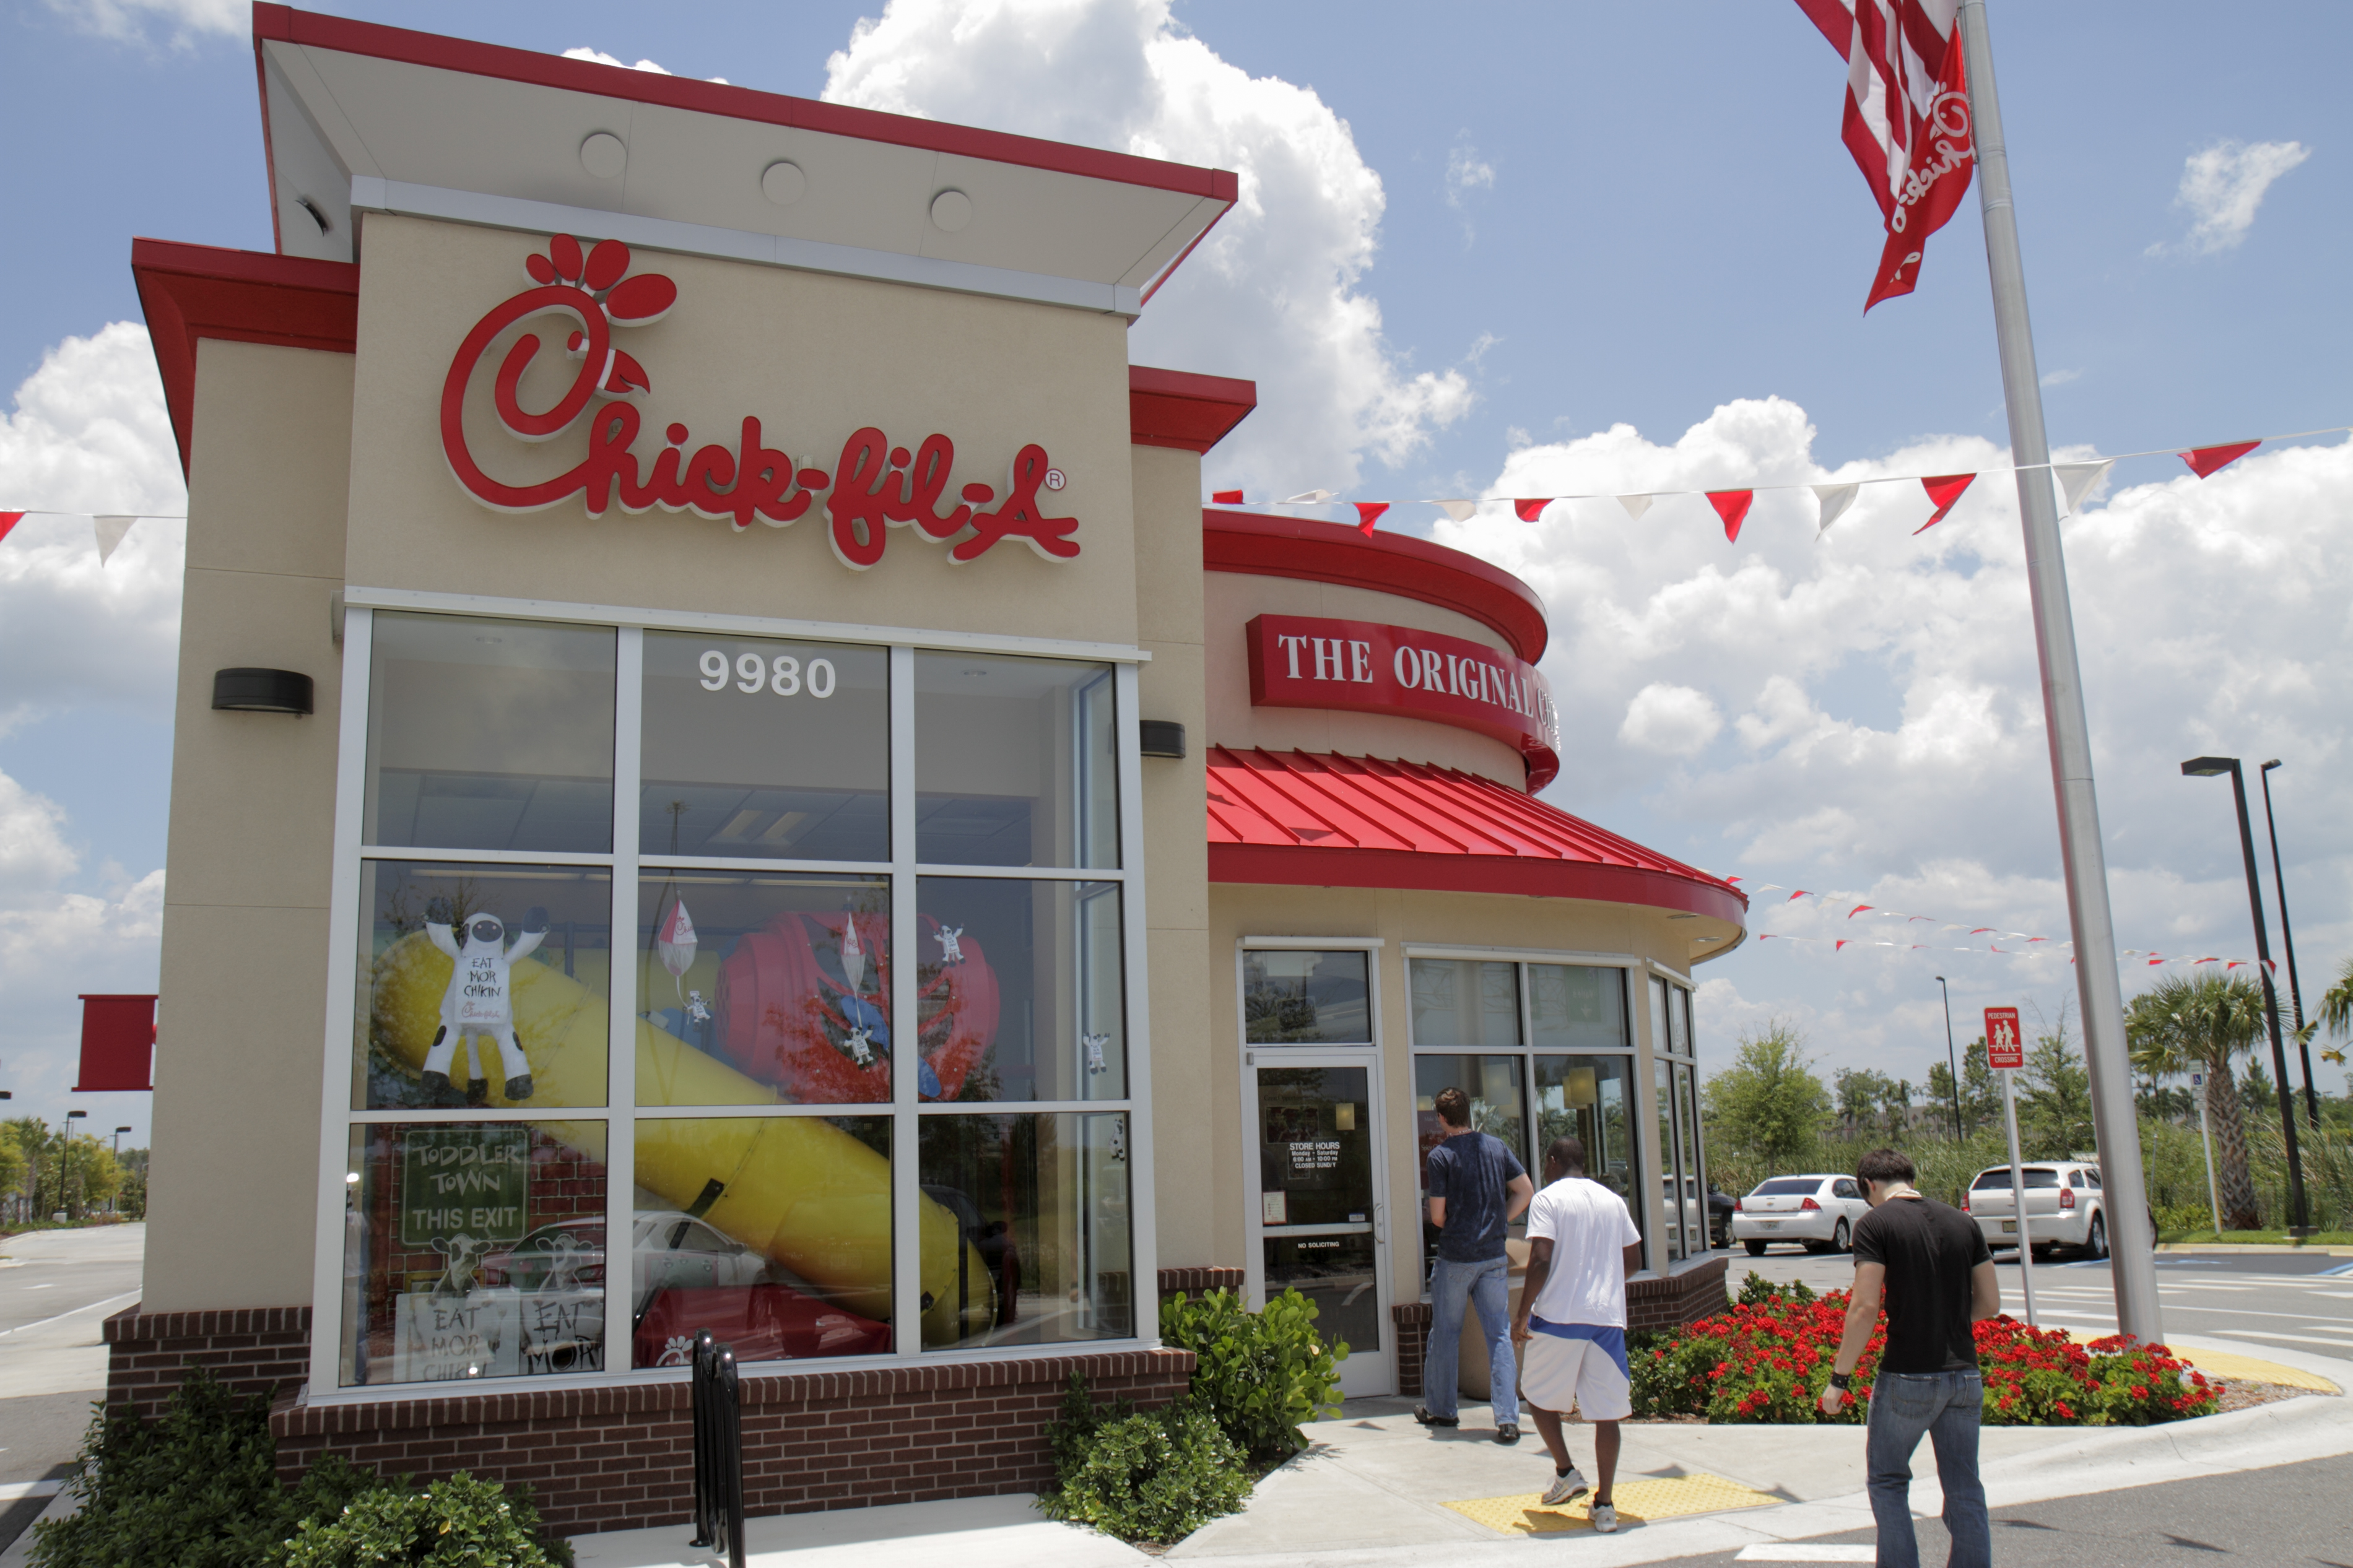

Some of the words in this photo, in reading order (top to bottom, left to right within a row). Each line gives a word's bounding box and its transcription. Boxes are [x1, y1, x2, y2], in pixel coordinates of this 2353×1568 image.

[440, 234, 1081, 570] Chick-fil-A
[699, 650, 836, 698] 9980
[1278, 634, 1373, 683] THE
[1393, 646, 1534, 718] ORIGINAL
[471, 956, 494, 969] EAT
[469, 970, 497, 985] MOR
[464, 984, 502, 998] CHIKIN
[1289, 1142, 1313, 1150] STORE
[1315, 1141, 1340, 1150] HOURS
[413, 1209, 463, 1230] THIS
[471, 1206, 518, 1229] EXIT
[433, 1306, 482, 1331] EAT
[534, 1301, 586, 1336] EAT
[432, 1334, 479, 1358] MOR
[526, 1335, 599, 1374] MOR
